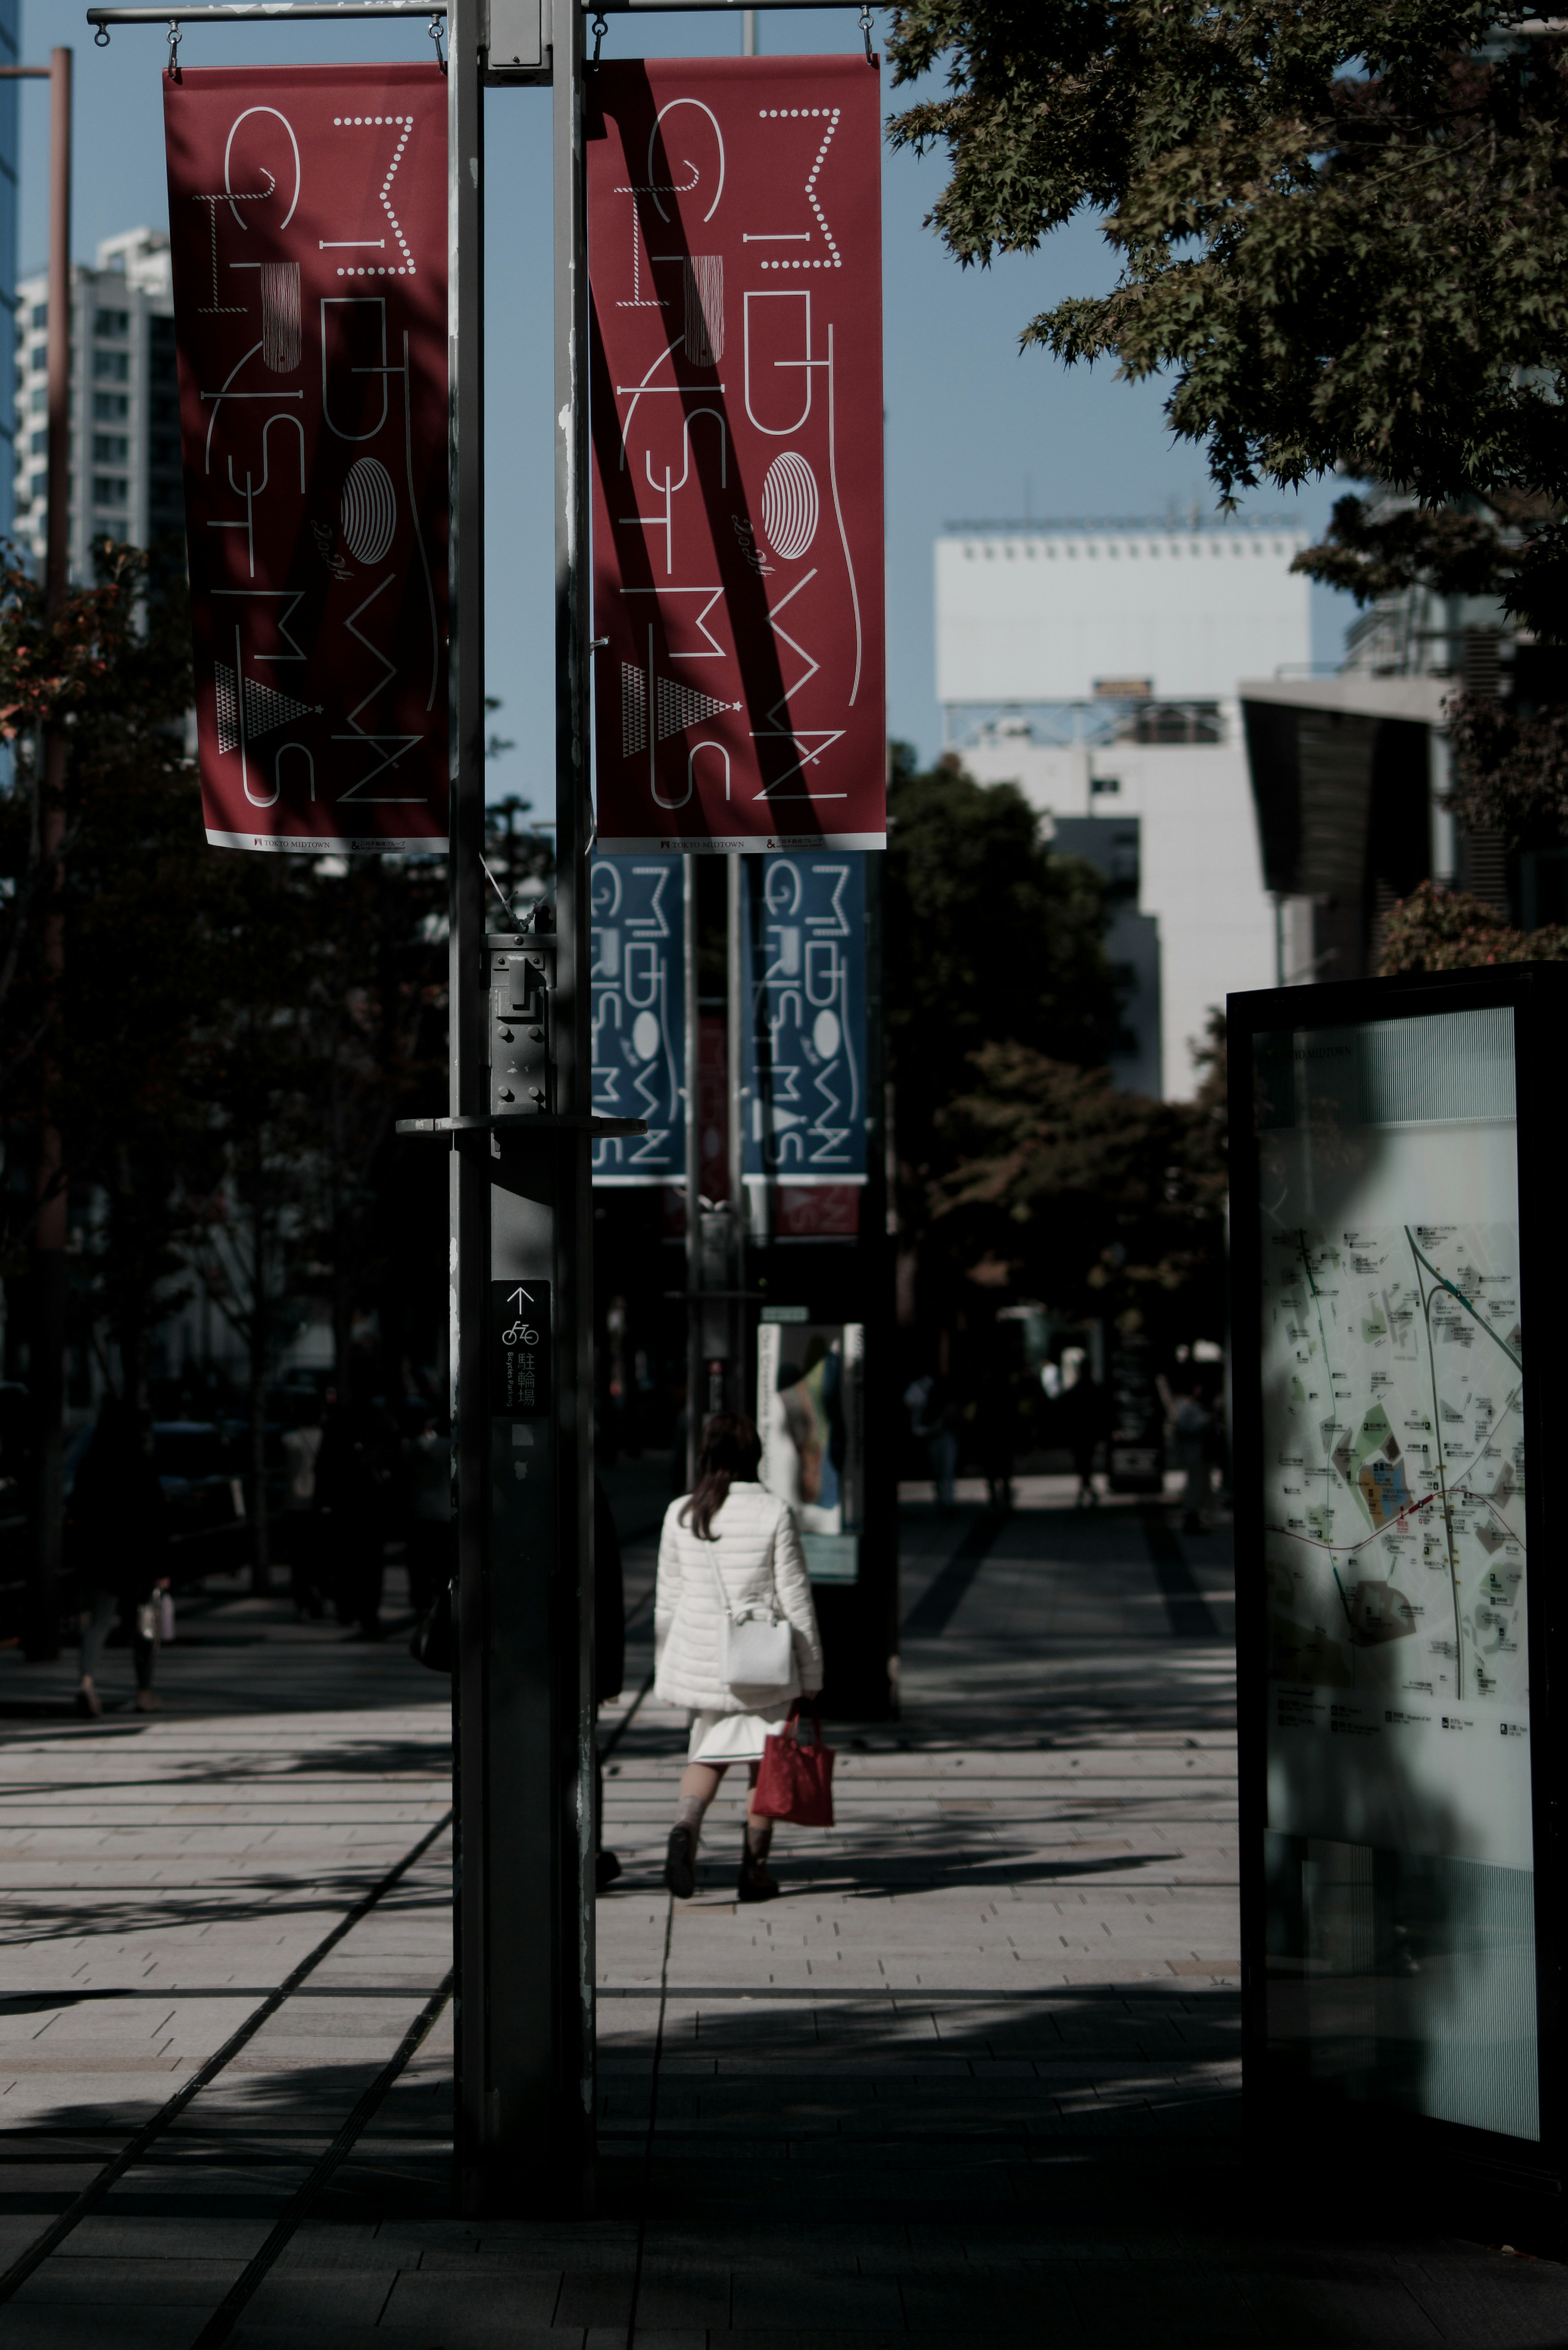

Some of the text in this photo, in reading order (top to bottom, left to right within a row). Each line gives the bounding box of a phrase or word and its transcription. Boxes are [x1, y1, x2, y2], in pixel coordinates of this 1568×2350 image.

[192, 106, 324, 807] CHRISTMAS
[309, 519, 351, 582] 2024
[319, 117, 439, 802] MIDTOWN
[613, 98, 743, 808] CHRISTMAS
[731, 513, 776, 577] 2024
[743, 108, 861, 800] MIDTOWN
[805, 864, 860, 1164] MIDTOWN
[517, 1353, 535, 1406] 駐輪場
